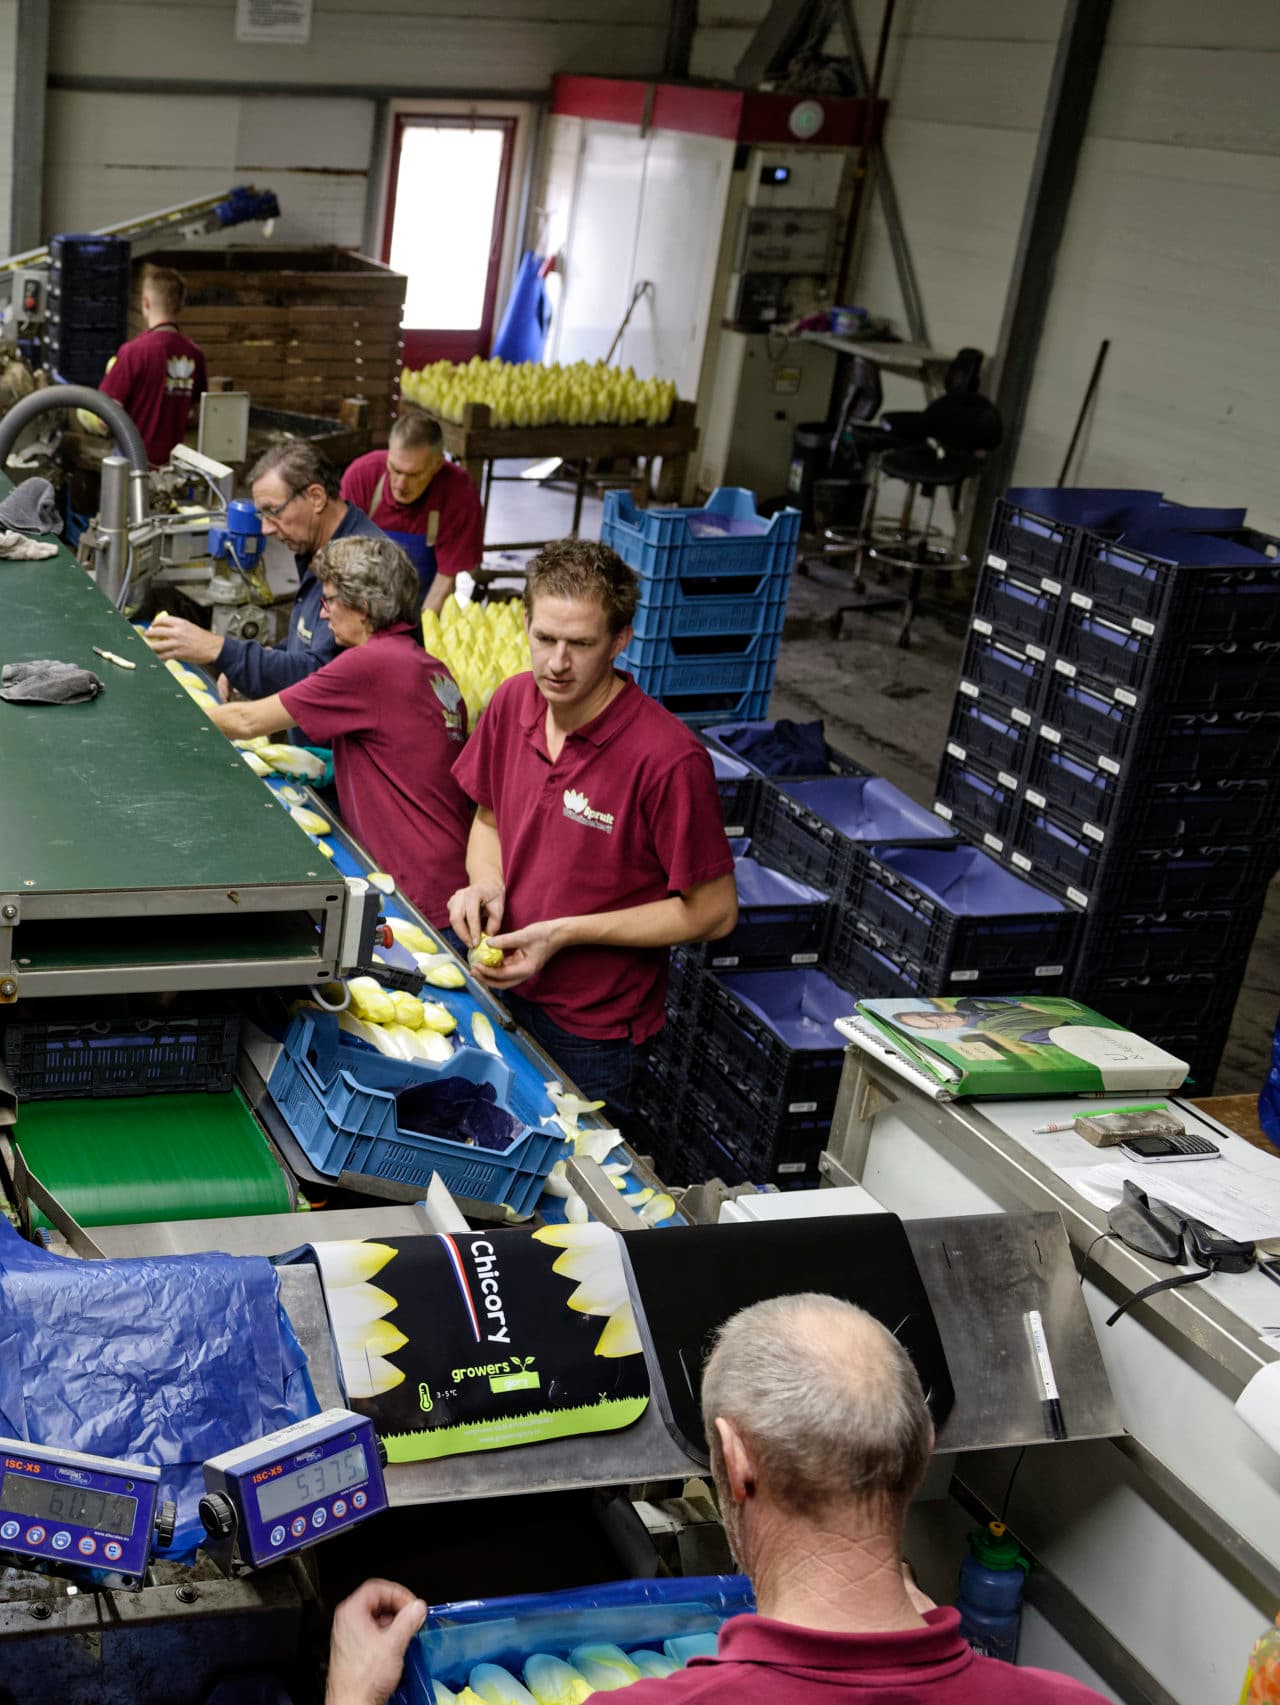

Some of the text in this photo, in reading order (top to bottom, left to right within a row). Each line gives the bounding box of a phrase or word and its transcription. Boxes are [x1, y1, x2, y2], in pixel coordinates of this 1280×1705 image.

[470, 1240, 511, 1344] Chicory
[451, 1361, 511, 1383] growers
[4, 1458, 41, 1473] ISC-XS
[252, 1465, 283, 1484] ISC-XS
